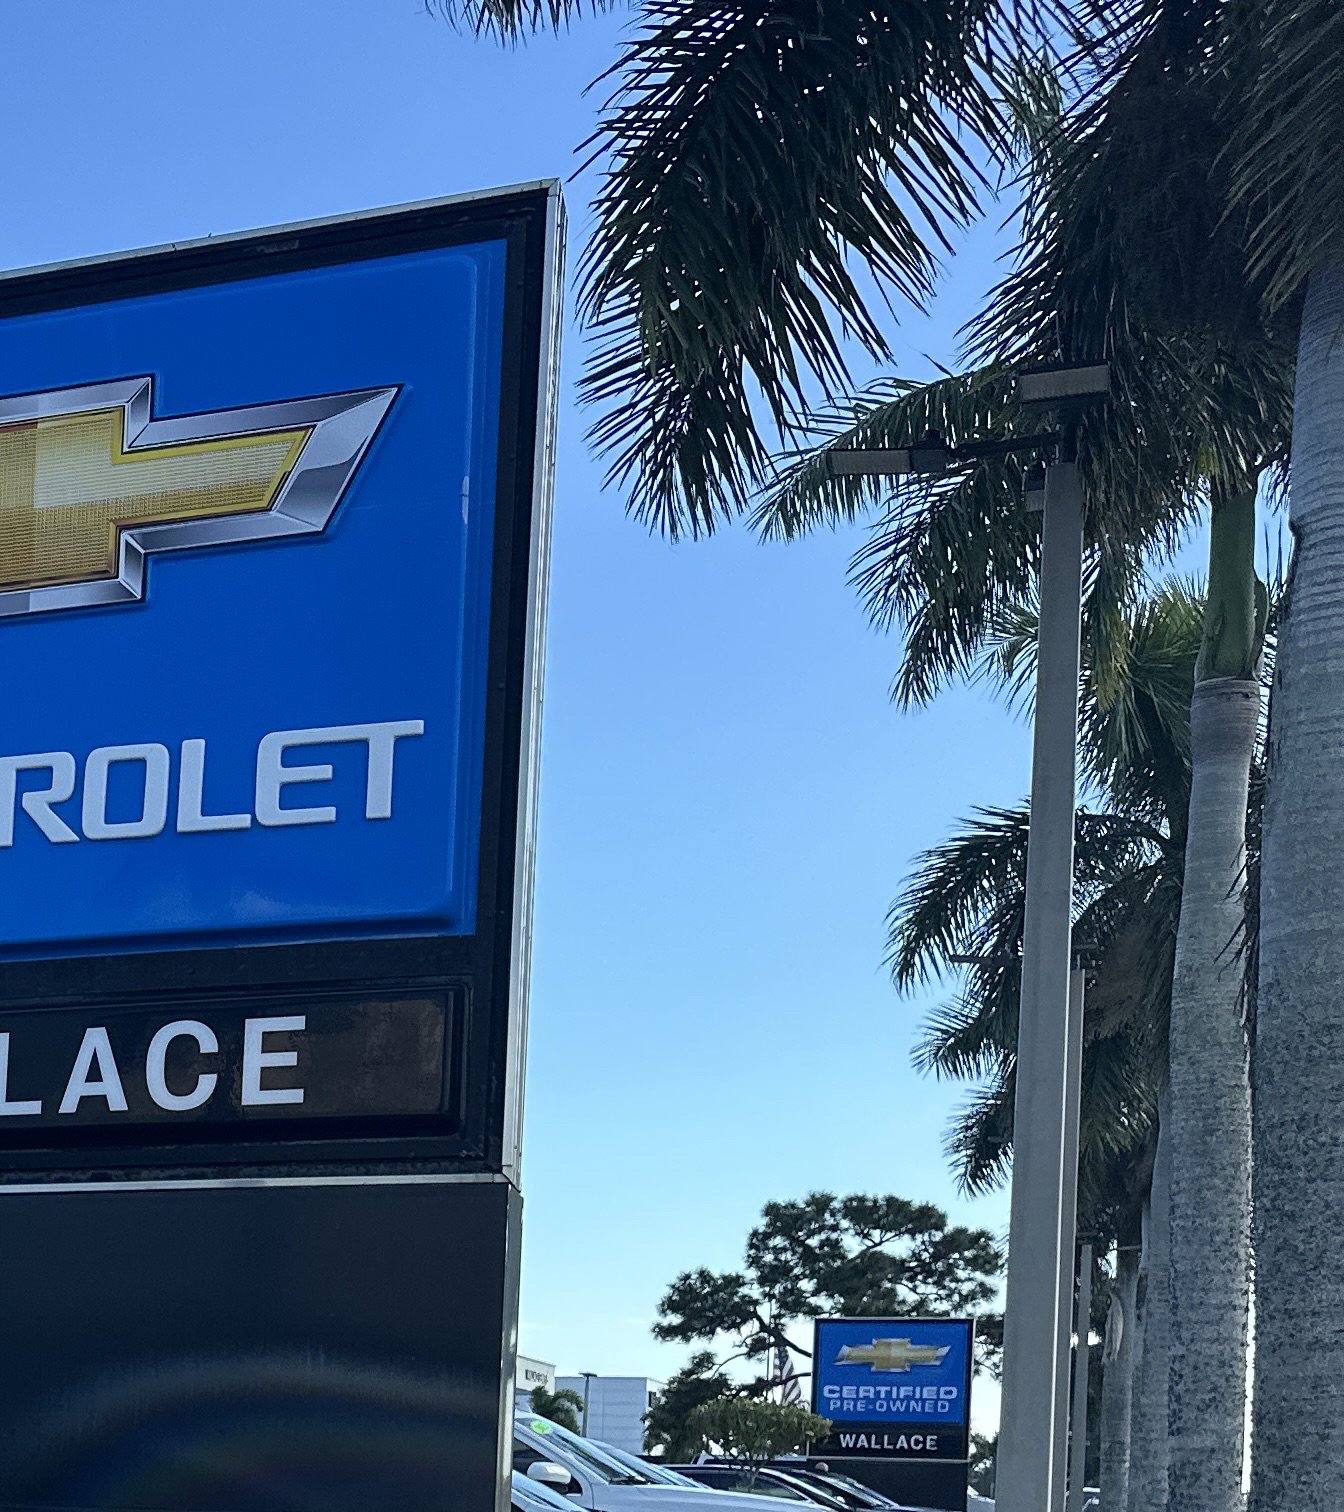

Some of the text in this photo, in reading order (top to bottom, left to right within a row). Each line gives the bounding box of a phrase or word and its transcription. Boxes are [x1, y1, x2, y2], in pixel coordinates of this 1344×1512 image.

[823, 1385, 958, 1400] CERTIFIED
[829, 1399, 949, 1413] PRE-OWNED
[839, 1433, 938, 1451] WALLACE
